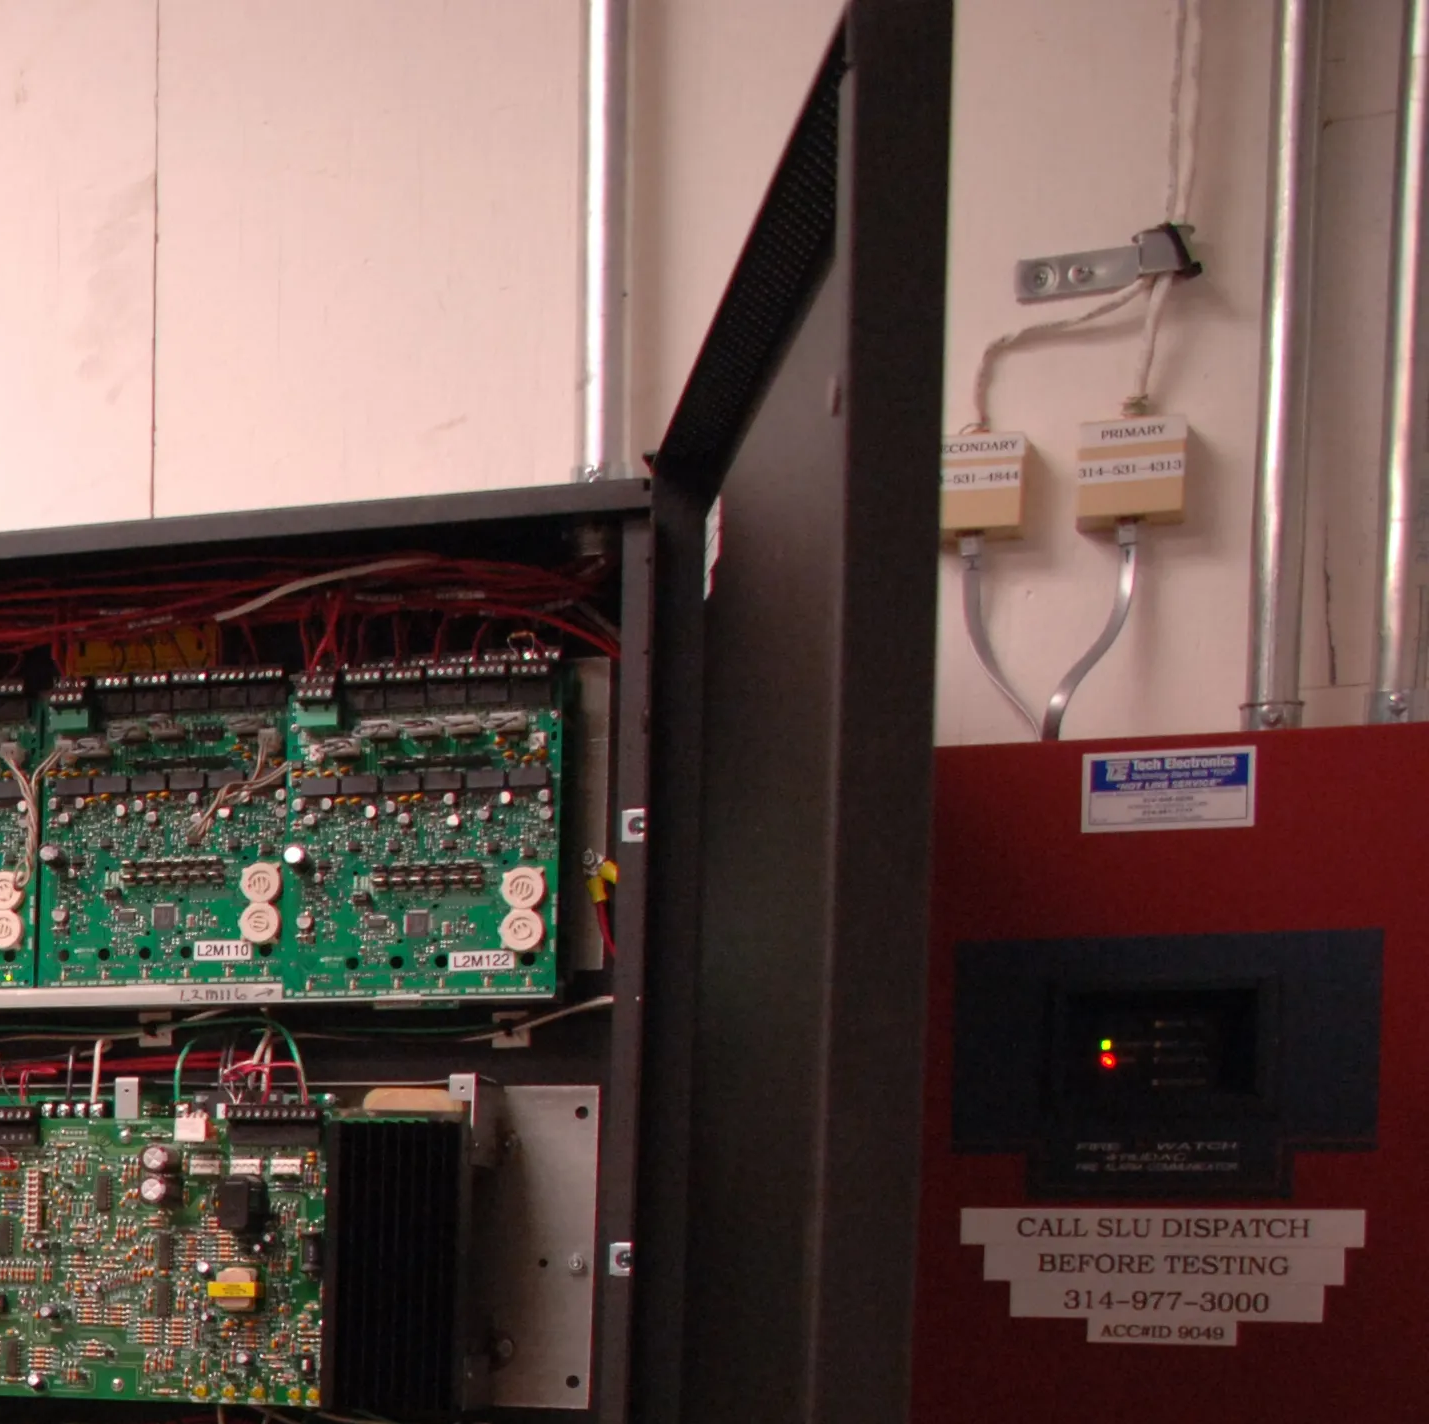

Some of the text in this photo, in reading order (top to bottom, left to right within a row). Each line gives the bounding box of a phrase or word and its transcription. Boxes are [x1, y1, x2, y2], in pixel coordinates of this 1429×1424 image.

[1101, 424, 1166, 440] PRIMARY
[941, 440, 1018, 454] ECONDARY
[1078, 459, 1183, 479] 314-531-4313
[1131, 758, 1161, 771] Tech
[1164, 755, 1235, 770] Electronics
[197, 944, 249, 957] L2M110
[453, 953, 510, 969] L2M122
[1156, 1141, 1237, 1151] WATCH
[1016, 1217, 1310, 1239] CALL SLU DISPATCH
[1037, 1253, 1290, 1276] BEFORE TESTING
[1063, 1289, 1269, 1314] 314-977-3000
[1178, 1325, 1224, 1340] 9049
